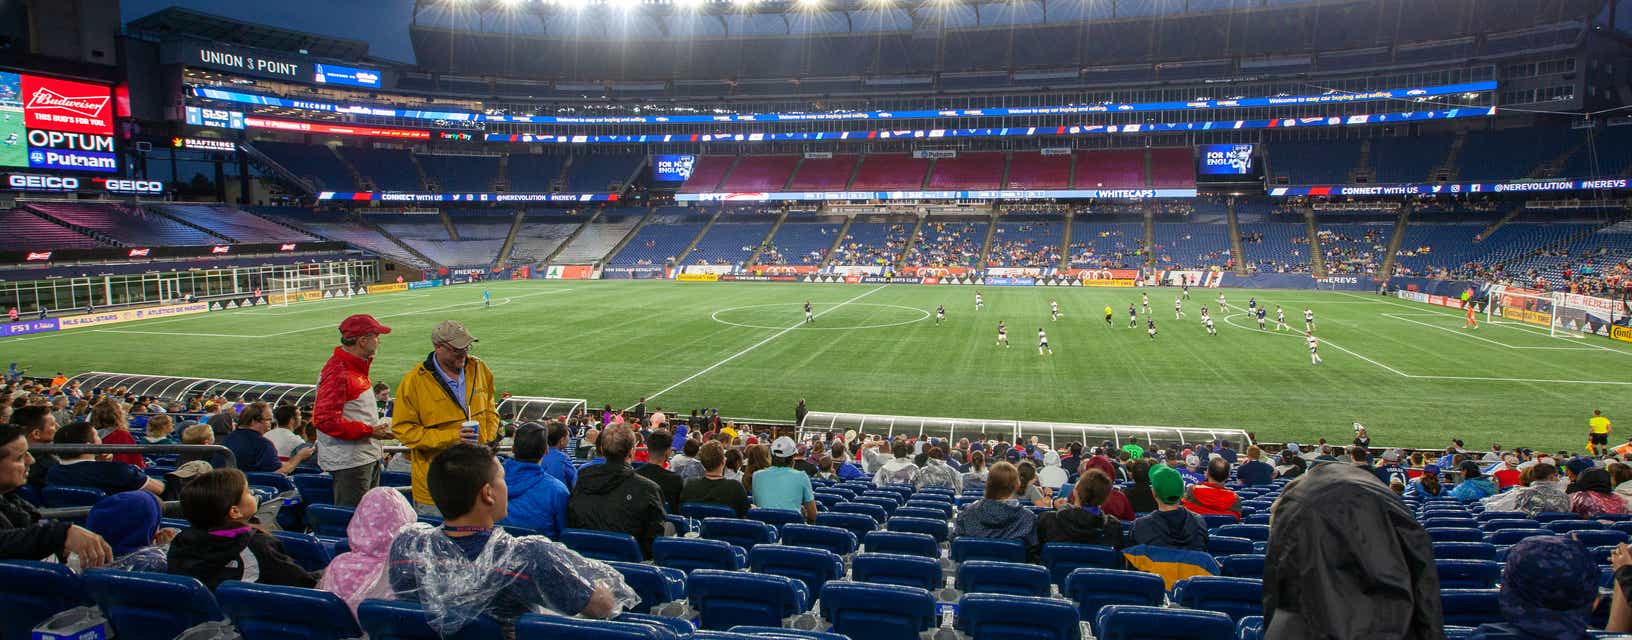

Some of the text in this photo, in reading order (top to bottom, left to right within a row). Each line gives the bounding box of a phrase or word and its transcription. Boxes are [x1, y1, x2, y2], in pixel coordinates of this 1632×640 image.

[201, 49, 243, 68] UNION
[257, 59, 298, 76] POINT
[33, 90, 104, 110] Budweiser
[293, 101, 332, 110] WELCOME
[34, 112, 51, 121] THIS
[53, 114, 74, 123] BUD'S
[75, 117, 89, 125] FOR
[28, 130, 114, 152] OPTUM
[185, 139, 235, 148] DRAFTKINGS
[46, 152, 116, 169] Putnam
[1207, 151, 1225, 159] FOR
[9, 174, 79, 189] GEICO
[105, 179, 163, 192] GEICO
[1494, 179, 1626, 192] @NEREVOLUTION #NEREVS
[1099, 190, 1153, 198] WHITECAPS
[1342, 187, 1382, 195] CONNECT
[1384, 186, 1405, 194] WITH
[11, 324, 30, 333] FS1
